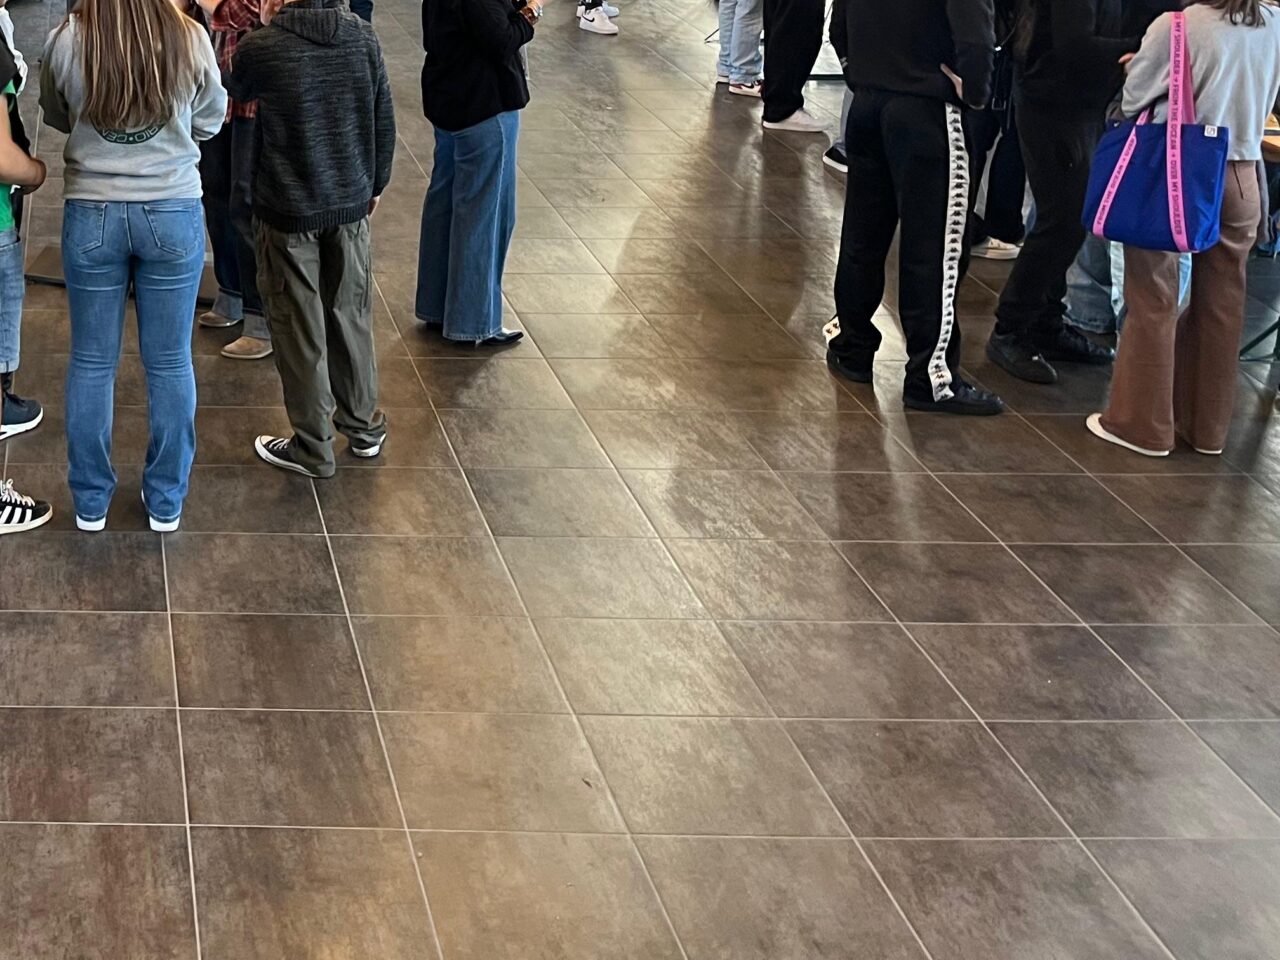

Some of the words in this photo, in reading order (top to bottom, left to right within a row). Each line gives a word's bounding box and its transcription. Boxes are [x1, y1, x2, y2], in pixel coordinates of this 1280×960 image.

[1173, 35, 1182, 74] SHOULDER
[1172, 84, 1180, 105] FROM
[1170, 160, 1178, 179] OVER
[1172, 194, 1182, 235] SHOULDER
